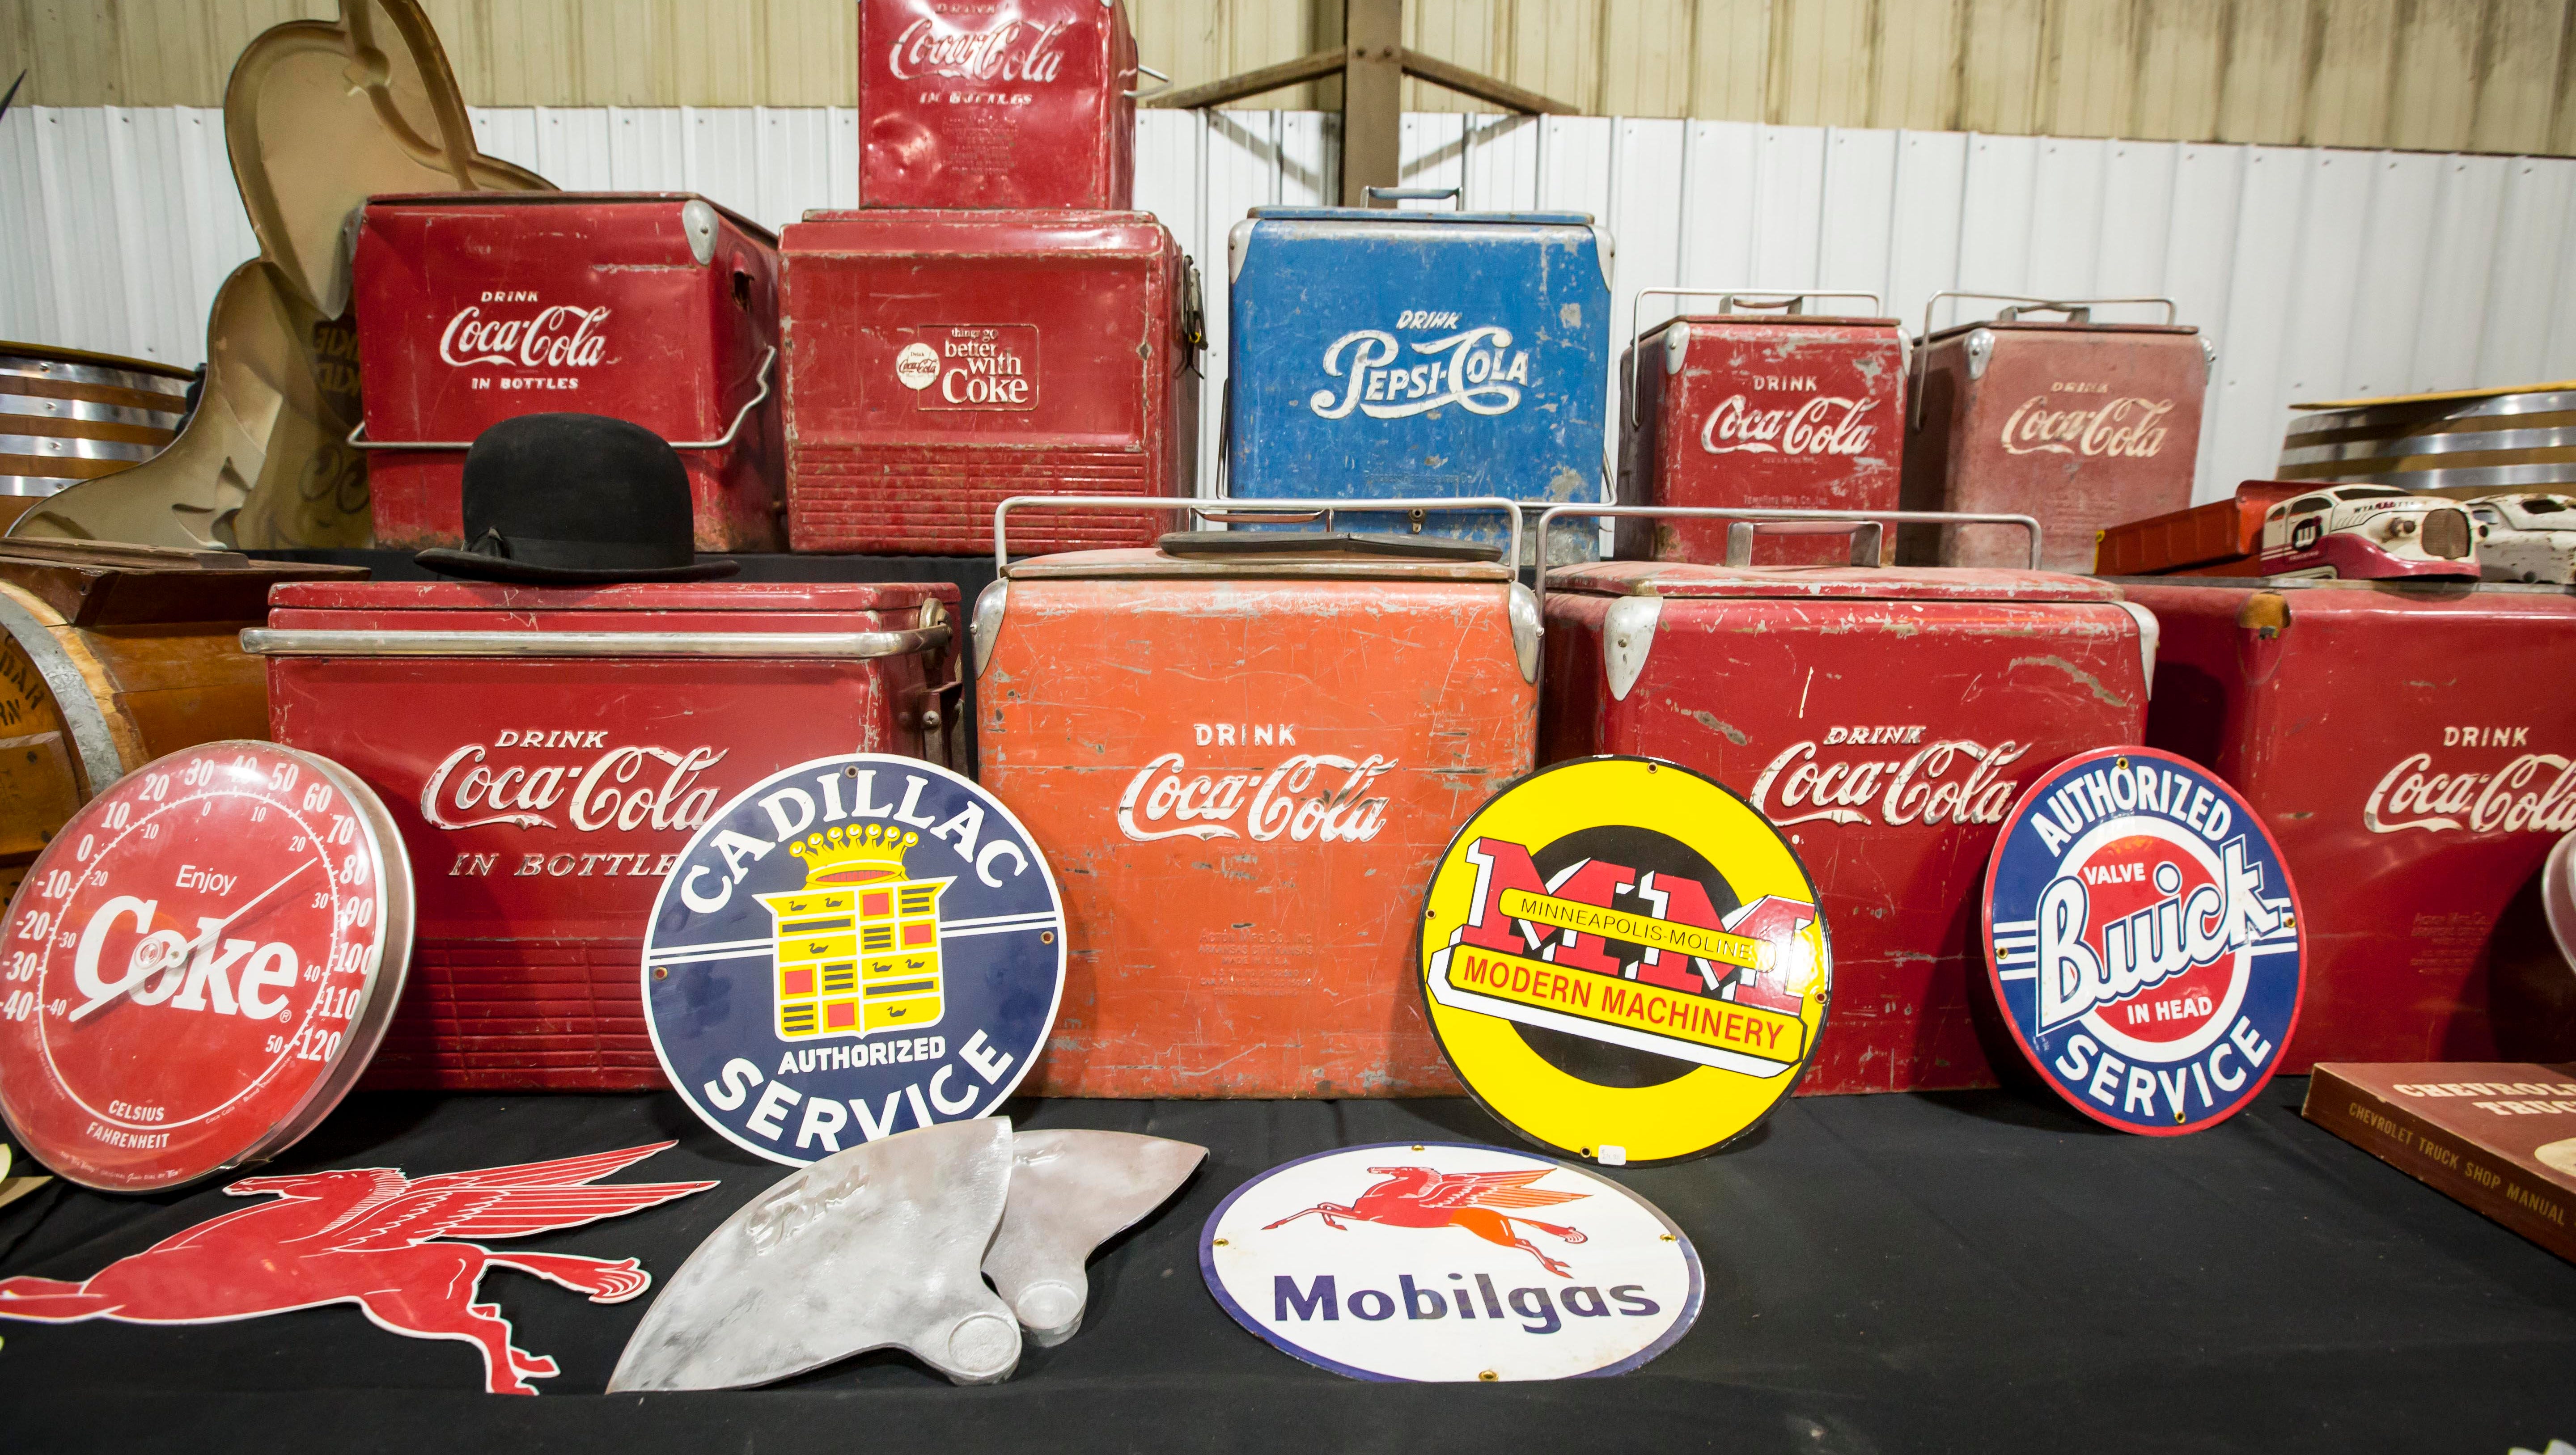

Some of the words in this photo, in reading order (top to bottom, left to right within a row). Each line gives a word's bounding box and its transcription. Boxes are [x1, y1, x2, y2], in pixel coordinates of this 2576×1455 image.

[889, 18, 1076, 82] Coca-Cola
[481, 291, 539, 302] DRINK
[1396, 310, 1463, 330] DRINK
[440, 305, 614, 367] Coca-Cola
[945, 339, 998, 358] better
[982, 330, 998, 343] go
[898, 359, 937, 374] Coca-Cola
[967, 348, 1023, 375] with
[472, 378, 490, 389] IN
[500, 378, 579, 389] BOTTLES
[942, 368, 1028, 403] Coke
[1753, 376, 1818, 391] DRINK
[2051, 381, 2108, 393] DRINK
[1701, 394, 1880, 454] Coca-Cola
[2001, 396, 2175, 457] Coca-Cola
[495, 730, 608, 749] DRINK
[1194, 723, 1296, 746] DRINK
[1823, 726, 1926, 745] DRINK
[2443, 726, 2530, 747] DRINK
[139, 773, 169, 801] 20
[184, 759, 215, 787] 30
[268, 762, 299, 792] 50
[420, 744, 730, 832] Coca-Cola
[1750, 740, 2033, 826] Coca-Cola
[202, 801, 211, 816] 0
[303, 782, 332, 812] 60
[1117, 753, 1399, 842] Coca-Cola
[2030, 765, 2232, 858] AUTHORIZED
[101, 801, 130, 829] 10
[250, 807, 267, 822] 10
[327, 814, 355, 845] 70
[77, 834, 93, 862] 0
[288, 836, 306, 852] 20
[681, 770, 1028, 914] CADILLAC
[176, 864, 237, 896] Enjoy
[339, 854, 370, 885] 80
[449, 853, 499, 876] IN
[514, 853, 679, 877] BOTTLE
[2083, 862, 2145, 886] VALVE
[37, 870, 72, 899] -10
[312, 892, 329, 909] 30
[346, 896, 373, 927] 90
[16, 910, 50, 940] -20
[1521, 897, 1751, 960] MINNEAPOLIS-MOLINE
[2036, 835, 2282, 1036] Buick
[3, 951, 37, 982] -30
[74, 895, 298, 1020] Coke
[334, 942, 374, 975] 100
[304, 964, 321, 982] 40
[319, 986, 361, 1020] 110
[1464, 956, 1592, 1007] MODERN
[1601, 986, 1785, 1050] MACHINERY
[2127, 1004, 2149, 1025] IN
[2157, 997, 2212, 1021] HEAD
[265, 1035, 283, 1053] 50
[297, 1028, 342, 1062] 120
[778, 1035, 946, 1075] AUTHORIZED
[2055, 1016, 2272, 1117] SERVICE
[703, 1028, 1014, 1152] SERVICE
[109, 1100, 165, 1121] CELSIUS
[86, 1121, 170, 1149] FAHRENHEIT
[2349, 1103, 2413, 1145] CHEVROLET
[2419, 1137, 2460, 1170] TRUCK
[2465, 1162, 2501, 1189] SHOP
[2507, 1184, 2564, 1226] MANUAL
[1275, 1273, 1660, 1334] Mobilgas
